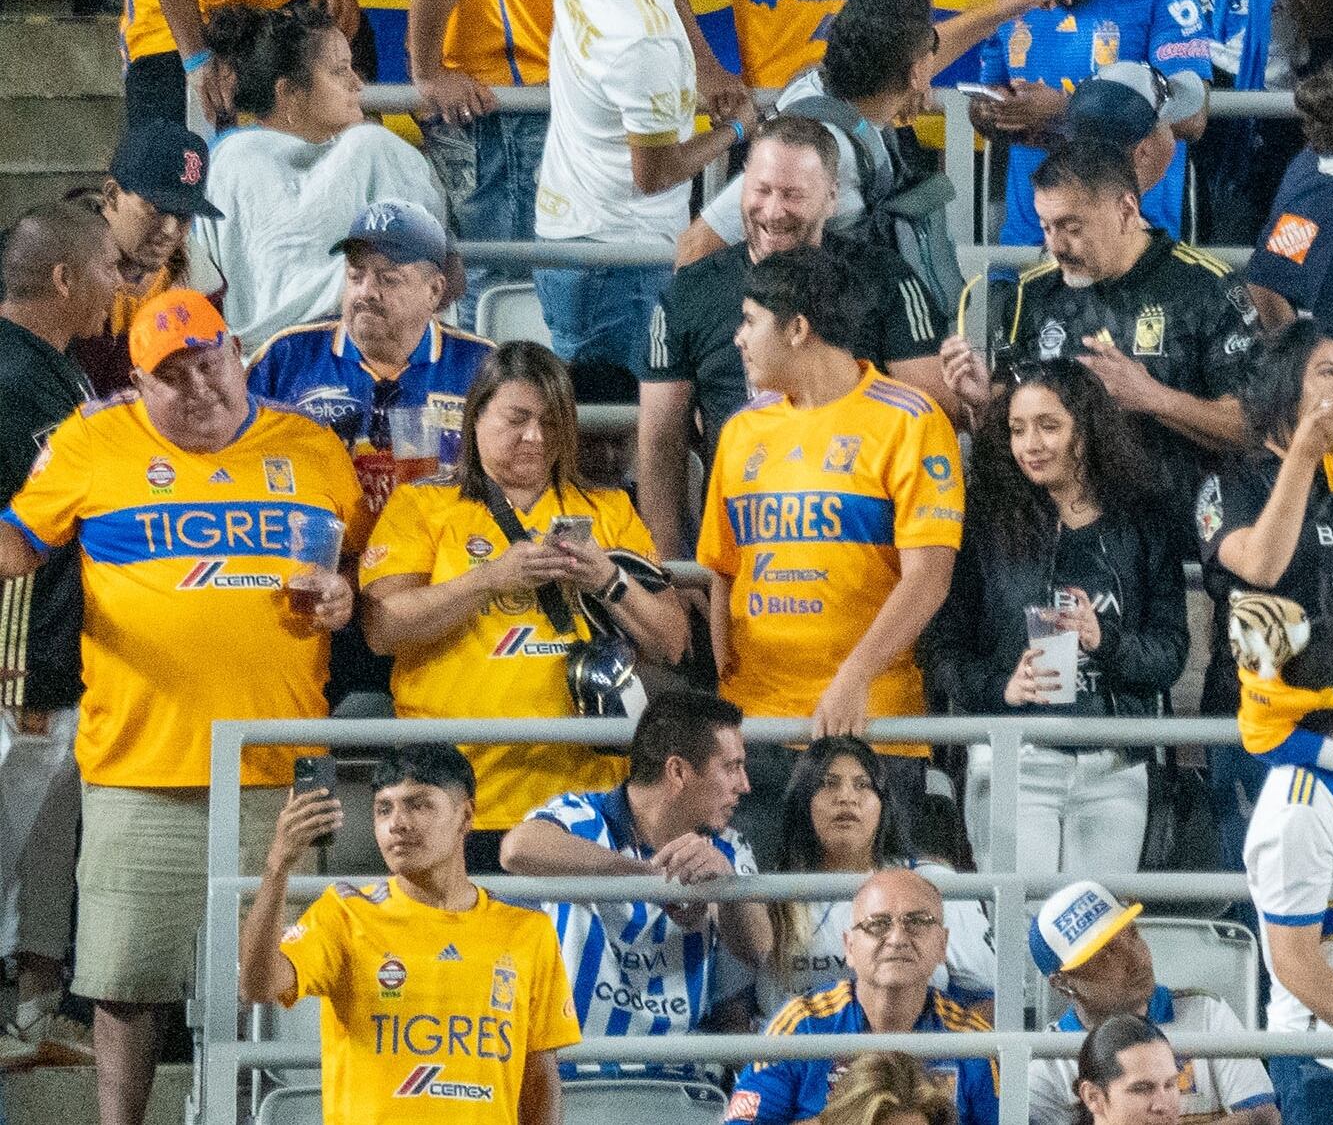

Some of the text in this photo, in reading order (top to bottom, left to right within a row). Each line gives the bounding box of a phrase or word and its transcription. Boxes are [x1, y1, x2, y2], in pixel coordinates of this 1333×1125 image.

[734, 495, 843, 541] TIGRES
[767, 595, 823, 615] Bitso
[596, 983, 687, 1017] codere
[372, 1014, 514, 1062] TIGRES
